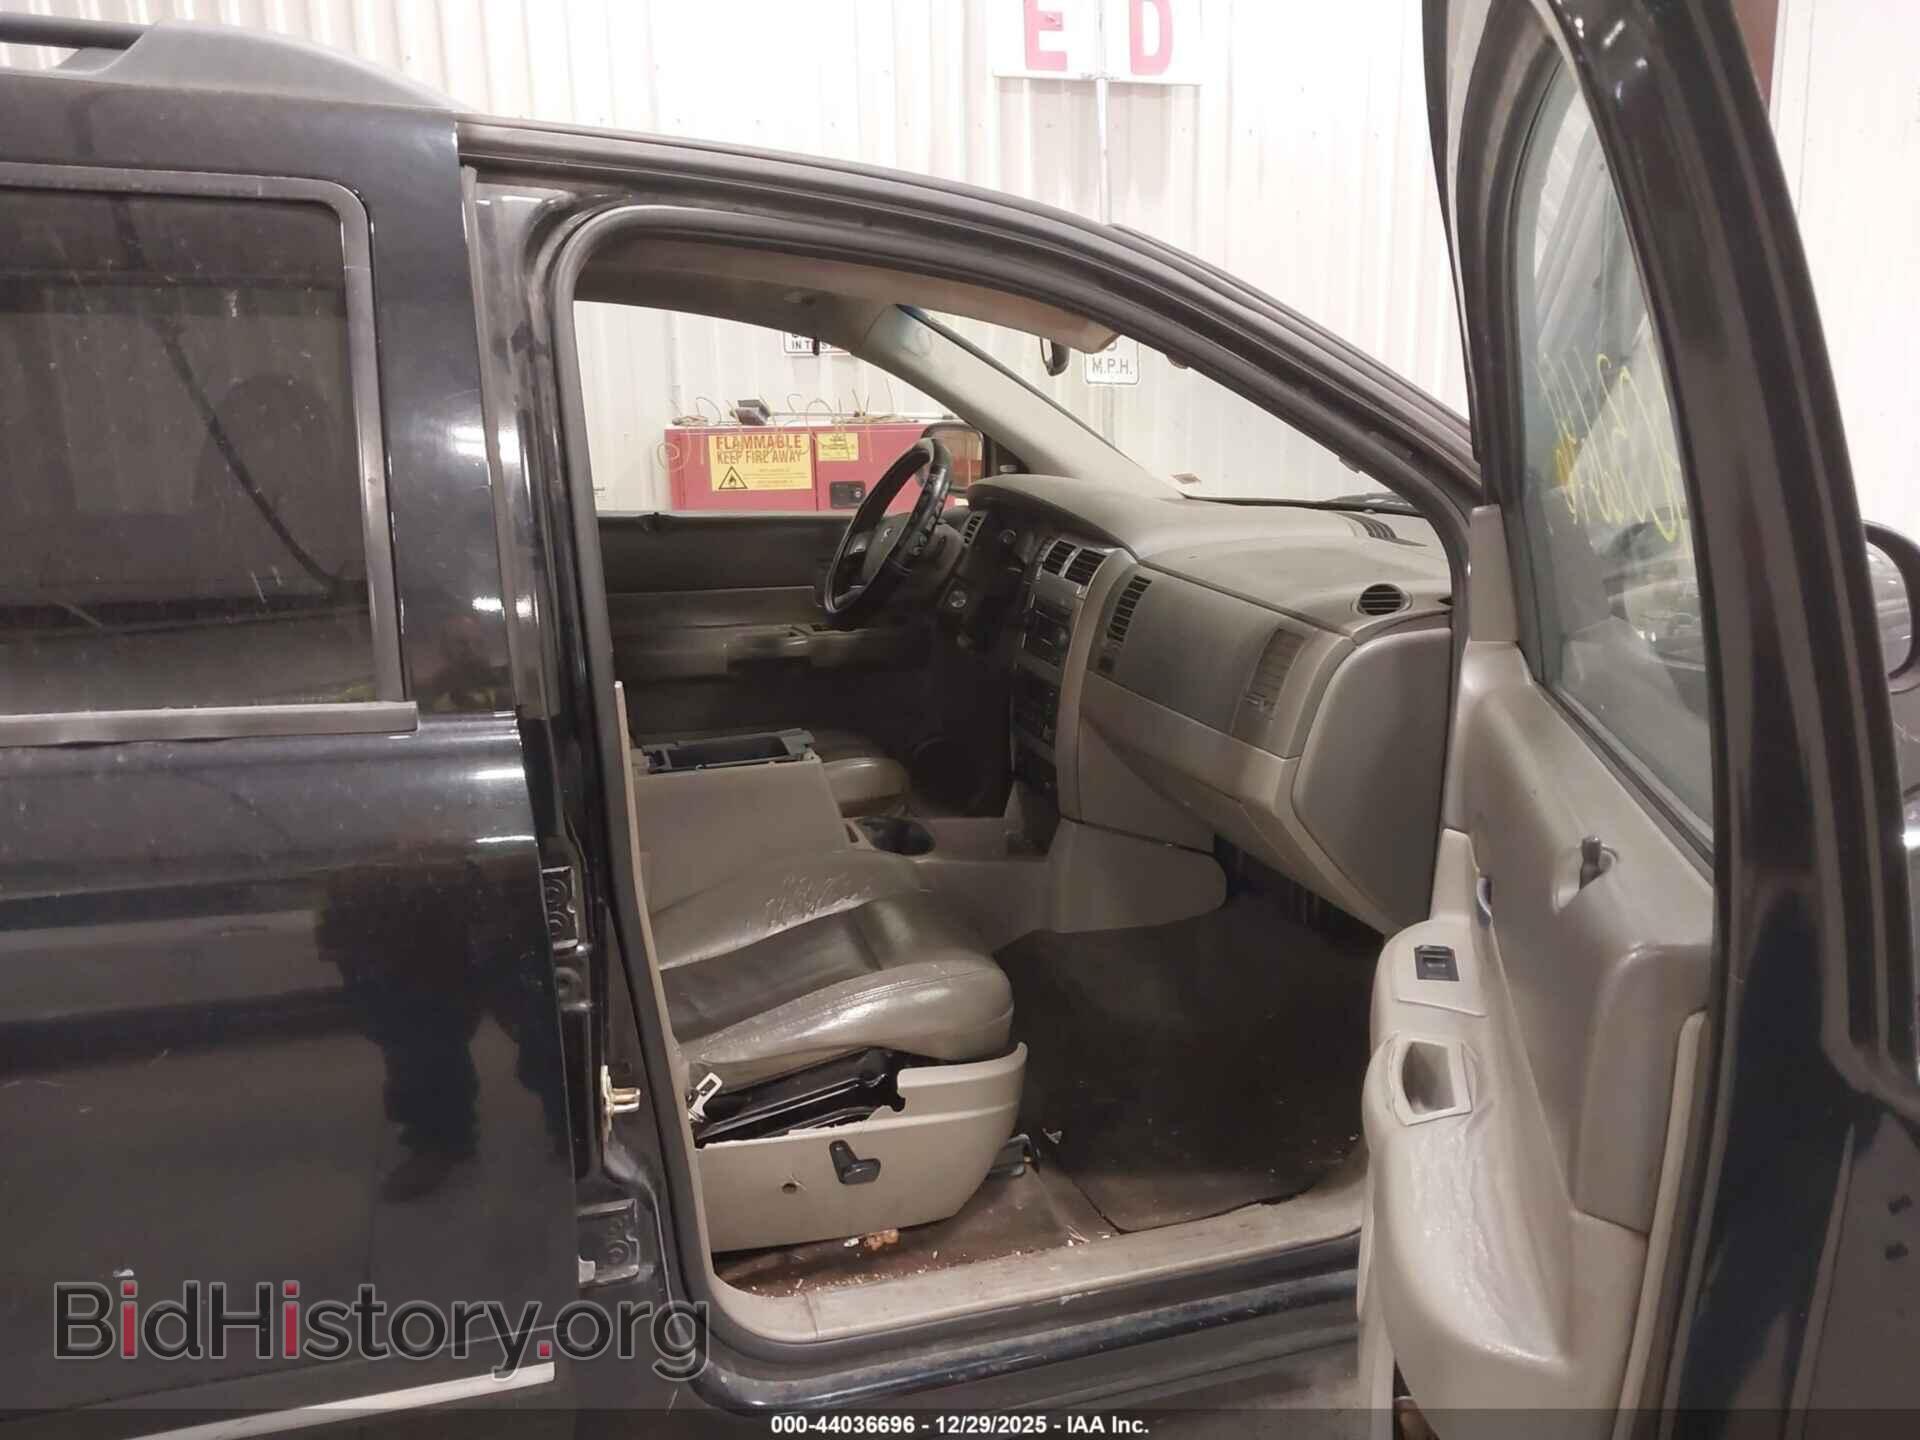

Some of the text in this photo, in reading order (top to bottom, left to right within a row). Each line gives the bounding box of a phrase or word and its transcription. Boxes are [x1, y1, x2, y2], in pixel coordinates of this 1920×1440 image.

[716, 435, 801, 449] FLAMMABLE
[717, 449, 802, 464] KEEP FIRE AWAY
